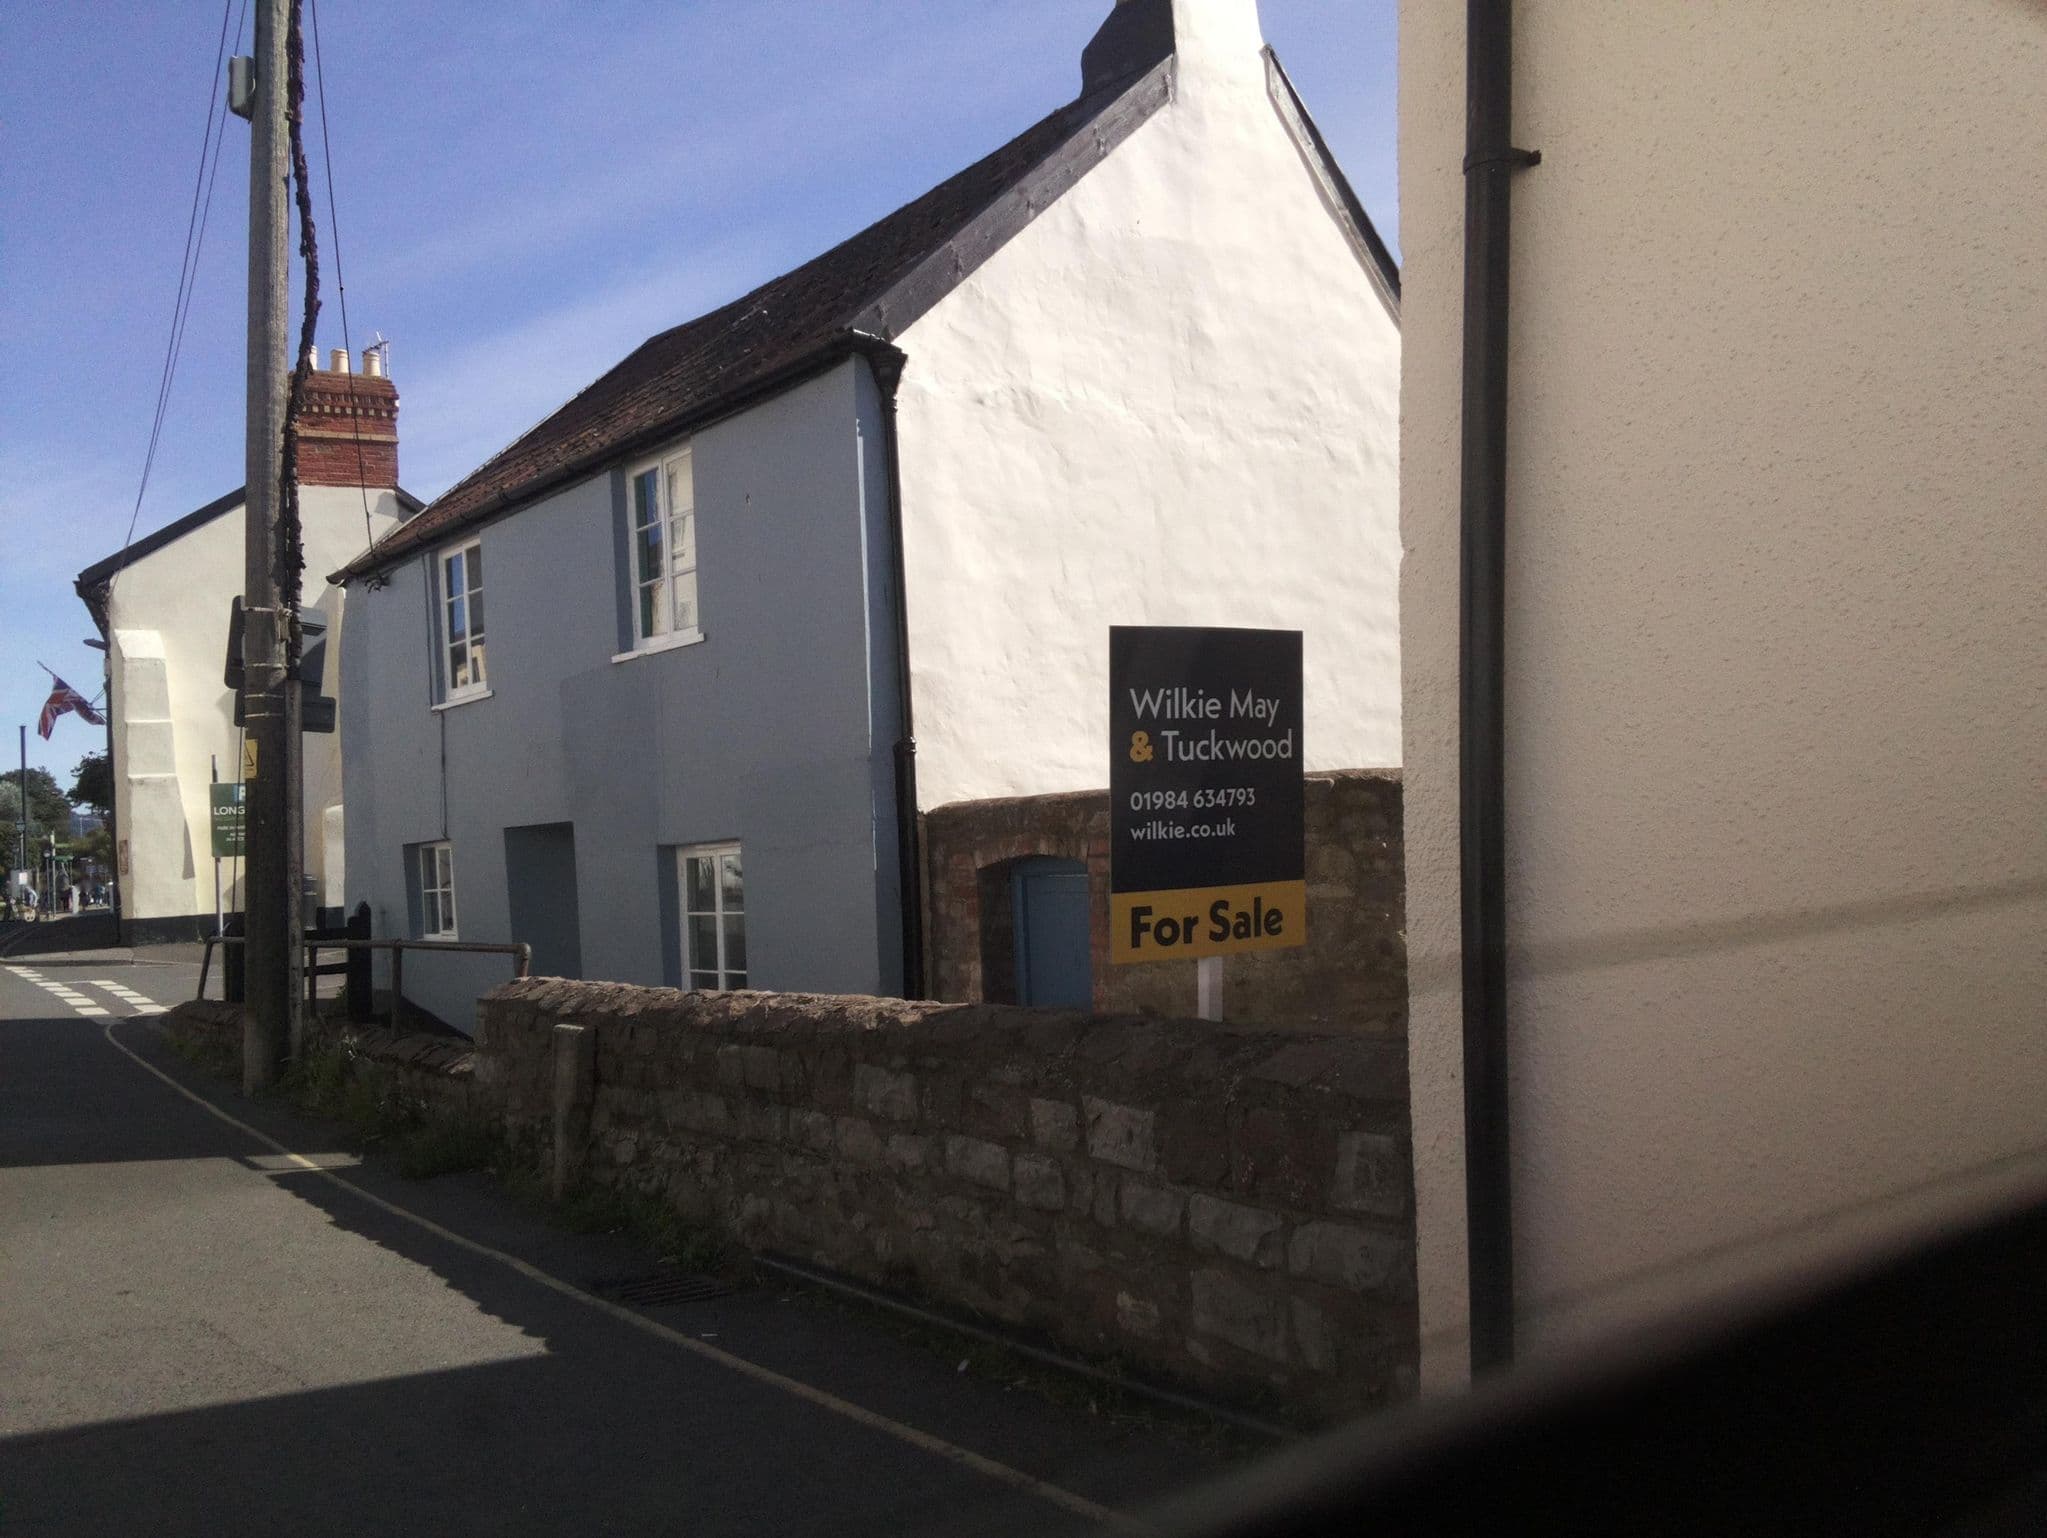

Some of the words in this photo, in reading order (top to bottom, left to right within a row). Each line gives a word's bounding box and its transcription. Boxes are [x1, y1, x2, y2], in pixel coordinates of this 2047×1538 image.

[1129, 688, 1222, 719] Wilkie
[1229, 688, 1280, 726] May
[1129, 730, 1153, 762] &
[1161, 729, 1292, 761] Tuckwood
[1130, 791, 1189, 811] 01984
[1193, 788, 1256, 808] 634793
[1130, 818, 1236, 841] wilkie.co.uk
[1130, 905, 1199, 949] For
[1209, 897, 1283, 943] Sale
